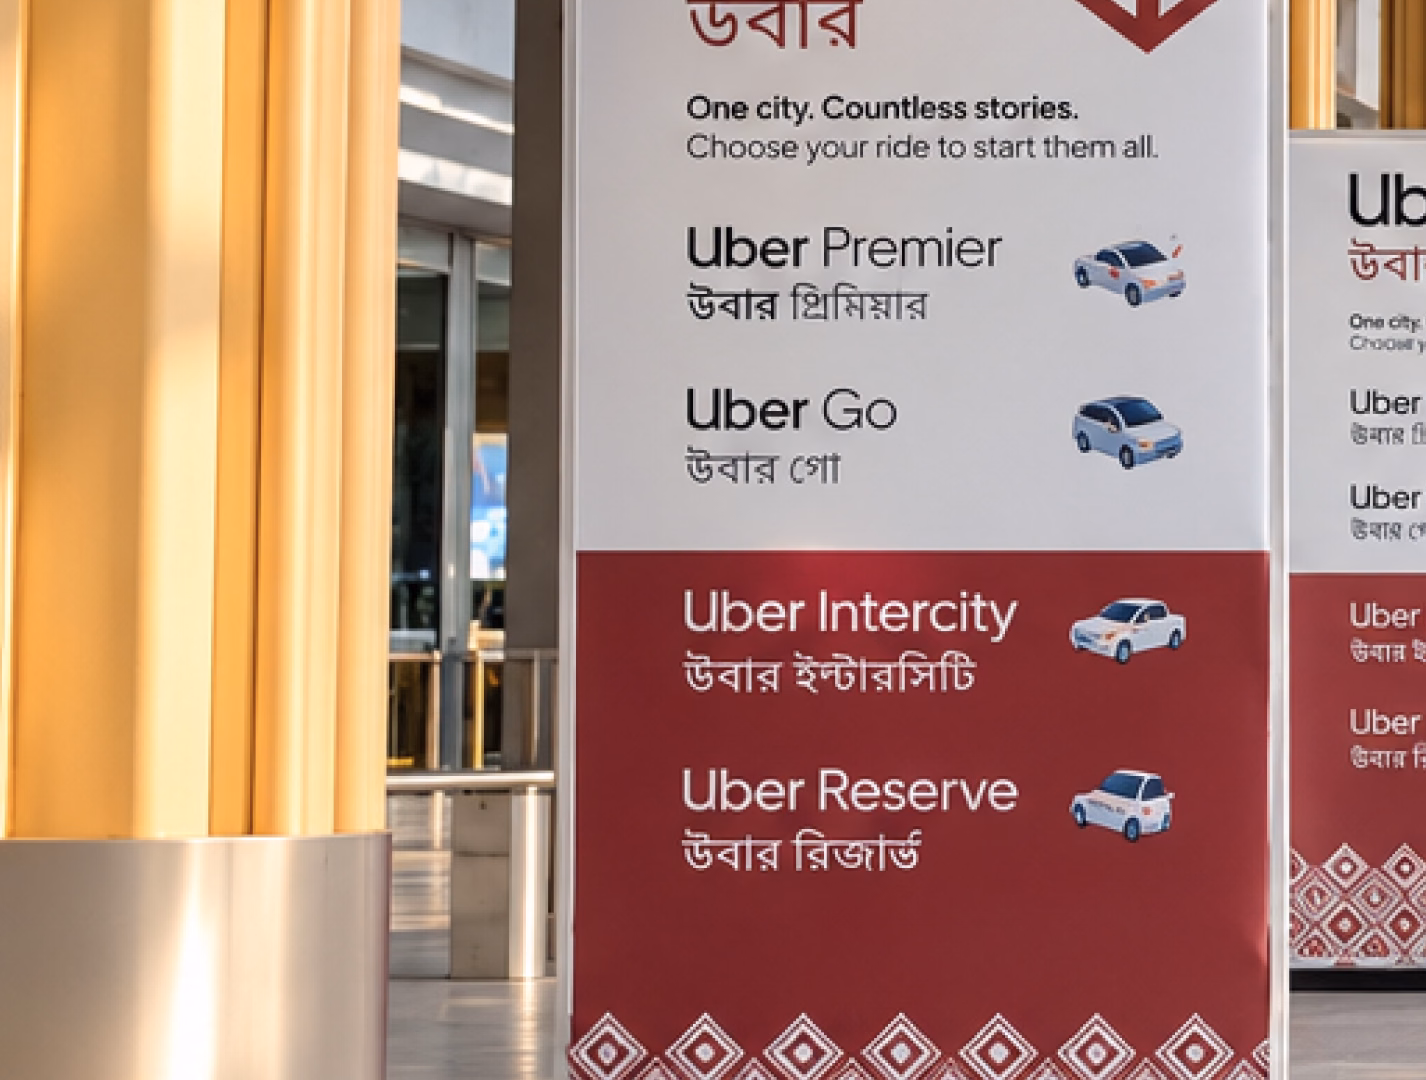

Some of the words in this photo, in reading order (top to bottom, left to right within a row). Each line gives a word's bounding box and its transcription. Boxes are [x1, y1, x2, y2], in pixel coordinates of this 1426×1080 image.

[687, 96, 749, 121] One
[757, 96, 813, 127] city.
[821, 96, 966, 119] Countless
[974, 96, 1078, 119] stories.
[687, 133, 799, 158] Choose
[807, 141, 869, 166] your
[877, 135, 930, 158] ride
[938, 136, 966, 158] to
[974, 138, 1036, 158] start
[1044, 135, 1116, 158] them
[1122, 135, 1158, 158] all.
[688, 227, 810, 269] Uber
[824, 227, 1002, 267] Premier
[687, 282, 779, 319] উবার
[687, 388, 810, 431] Uber
[824, 389, 896, 430] Go
[1351, 389, 1421, 414] Uber
[685, 445, 780, 484] উবার
[790, 453, 841, 484] গো
[1351, 486, 1421, 509] Uber
[685, 590, 805, 631] Uber
[821, 589, 1017, 642] Intercity
[1351, 603, 1420, 628] Uber
[684, 651, 782, 692] উবার
[793, 650, 977, 693] ইন্টারসিটি
[1351, 709, 1420, 734] Uber
[684, 768, 805, 810] Uber
[819, 768, 1019, 810] Reserve
[682, 829, 782, 871] উবার
[791, 829, 922, 871] রিজার্ভ
